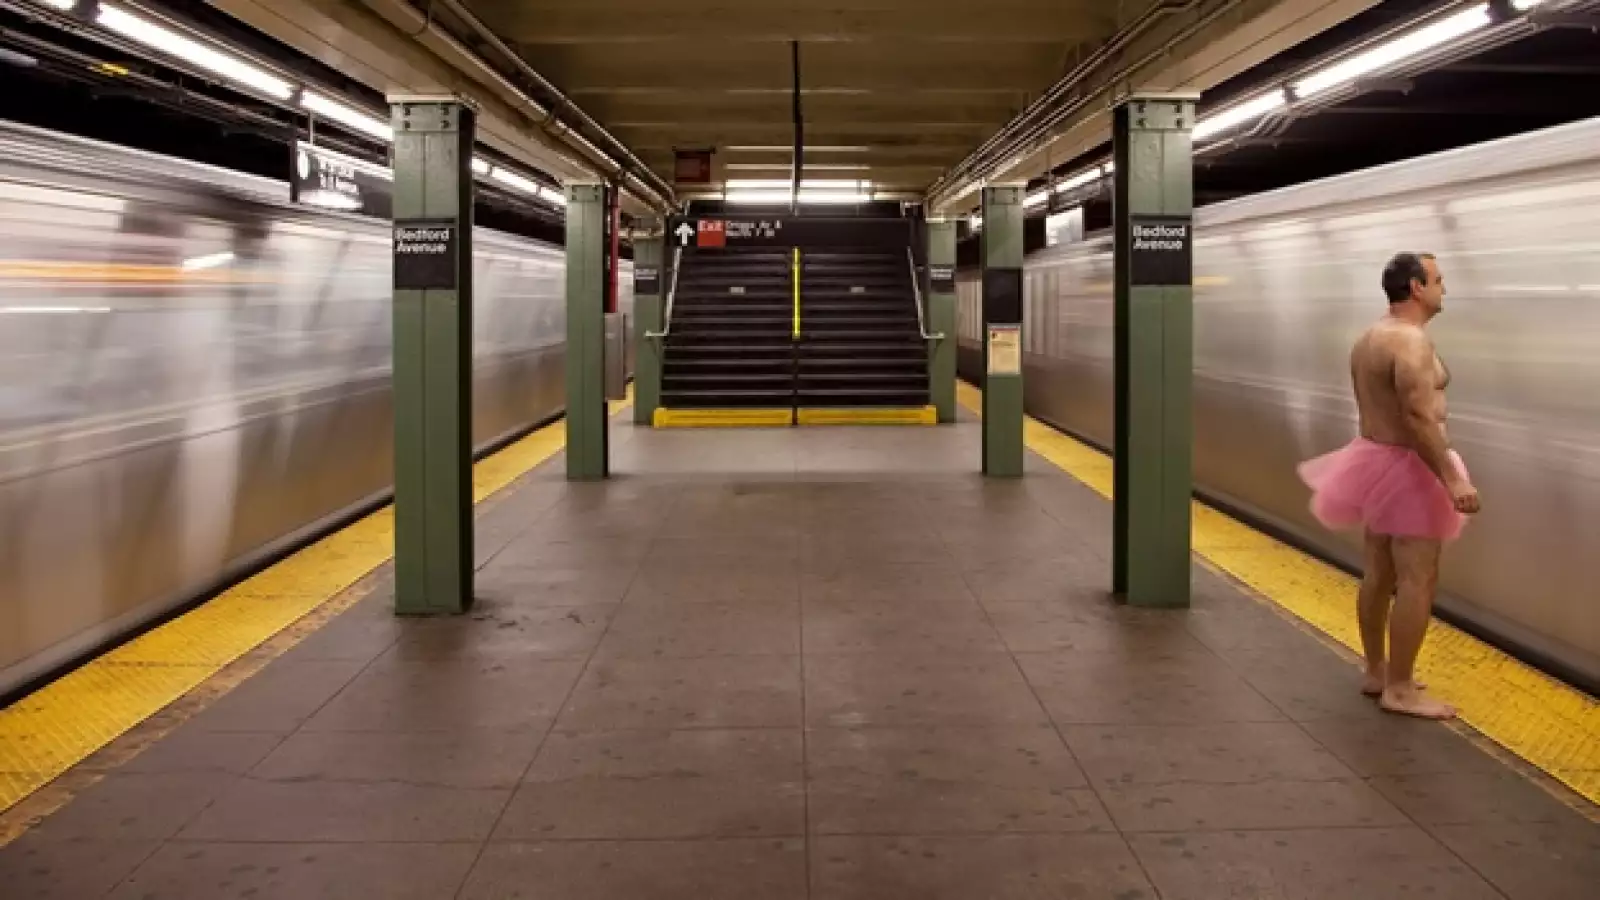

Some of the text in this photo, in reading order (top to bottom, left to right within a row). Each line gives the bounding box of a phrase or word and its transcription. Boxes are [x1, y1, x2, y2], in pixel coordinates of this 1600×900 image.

[698, 220, 723, 232] Exit
[1133, 225, 1186, 237] Bedford
[395, 228, 450, 241] Bedford
[396, 242, 447, 254] Avenue
[1133, 237, 1183, 250] Avenue
